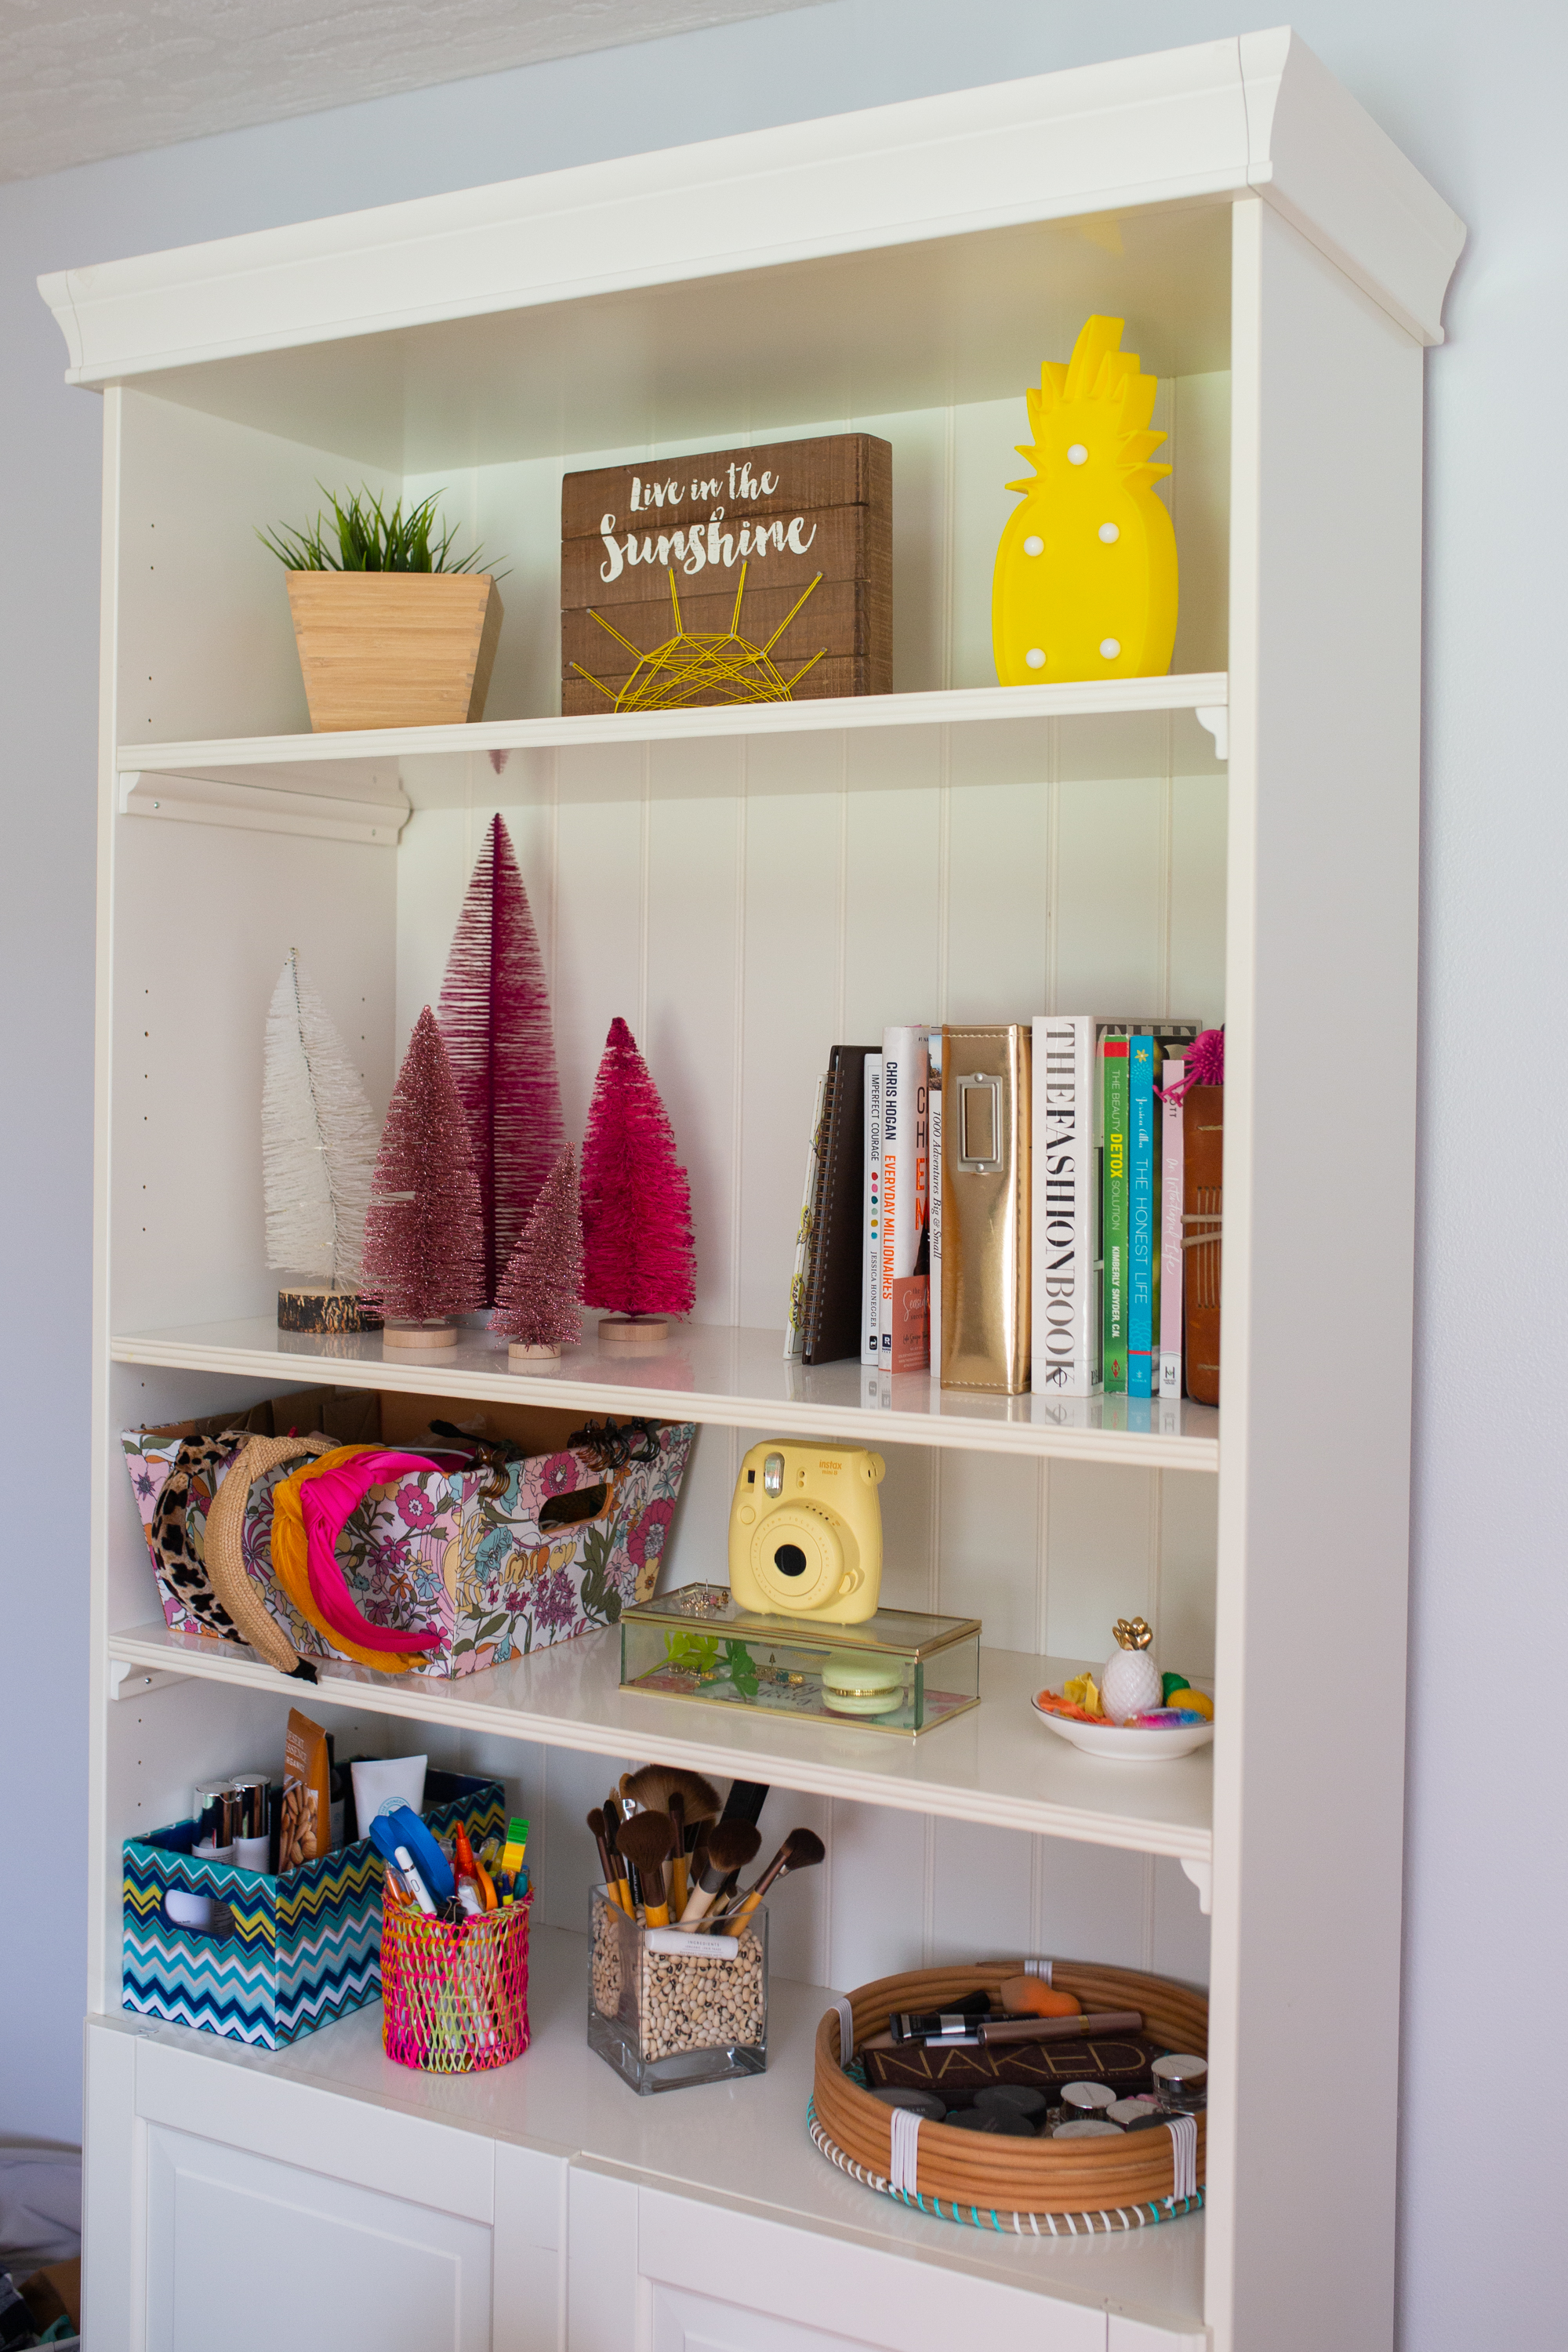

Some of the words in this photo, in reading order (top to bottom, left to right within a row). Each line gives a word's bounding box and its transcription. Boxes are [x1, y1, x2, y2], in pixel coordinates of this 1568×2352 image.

[630, 477, 685, 512] Live
[690, 477, 723, 501] in
[725, 461, 779, 500] the
[600, 506, 817, 583] Sunshine
[871, 1074, 880, 1119] IMPERFECT
[885, 1062, 898, 1097] CHRIS
[1111, 1069, 1120, 1090] THE
[884, 1100, 897, 1141] HOGAN
[932, 1111, 942, 1138] 1000
[1111, 1092, 1120, 1132] BEAUTY
[870, 1122, 880, 1161] COURAGE
[1110, 1133, 1123, 1178] DETOX
[1138, 1128, 1149, 1149] Alba
[884, 1155, 896, 1215] EVERYDAY
[932, 1139, 942, 1195] Adventures
[1134, 1158, 1149, 1190] THE
[931, 1197, 942, 1216] Big
[933, 1218, 940, 1228] &
[1111, 1179, 1120, 1230] SOLUTION
[933, 1229, 942, 1259] Small
[1134, 1197, 1149, 1265] HONEST
[882, 1218, 895, 1300] MILLIONAIRES
[1111, 1246, 1120, 1286] KIMBERLY
[1111, 1287, 1120, 1323] SNYDER,
[1134, 1272, 1148, 1305] LIFE
[818, 1459, 842, 1470] instax
[873, 2042, 1146, 2081] NAKED
